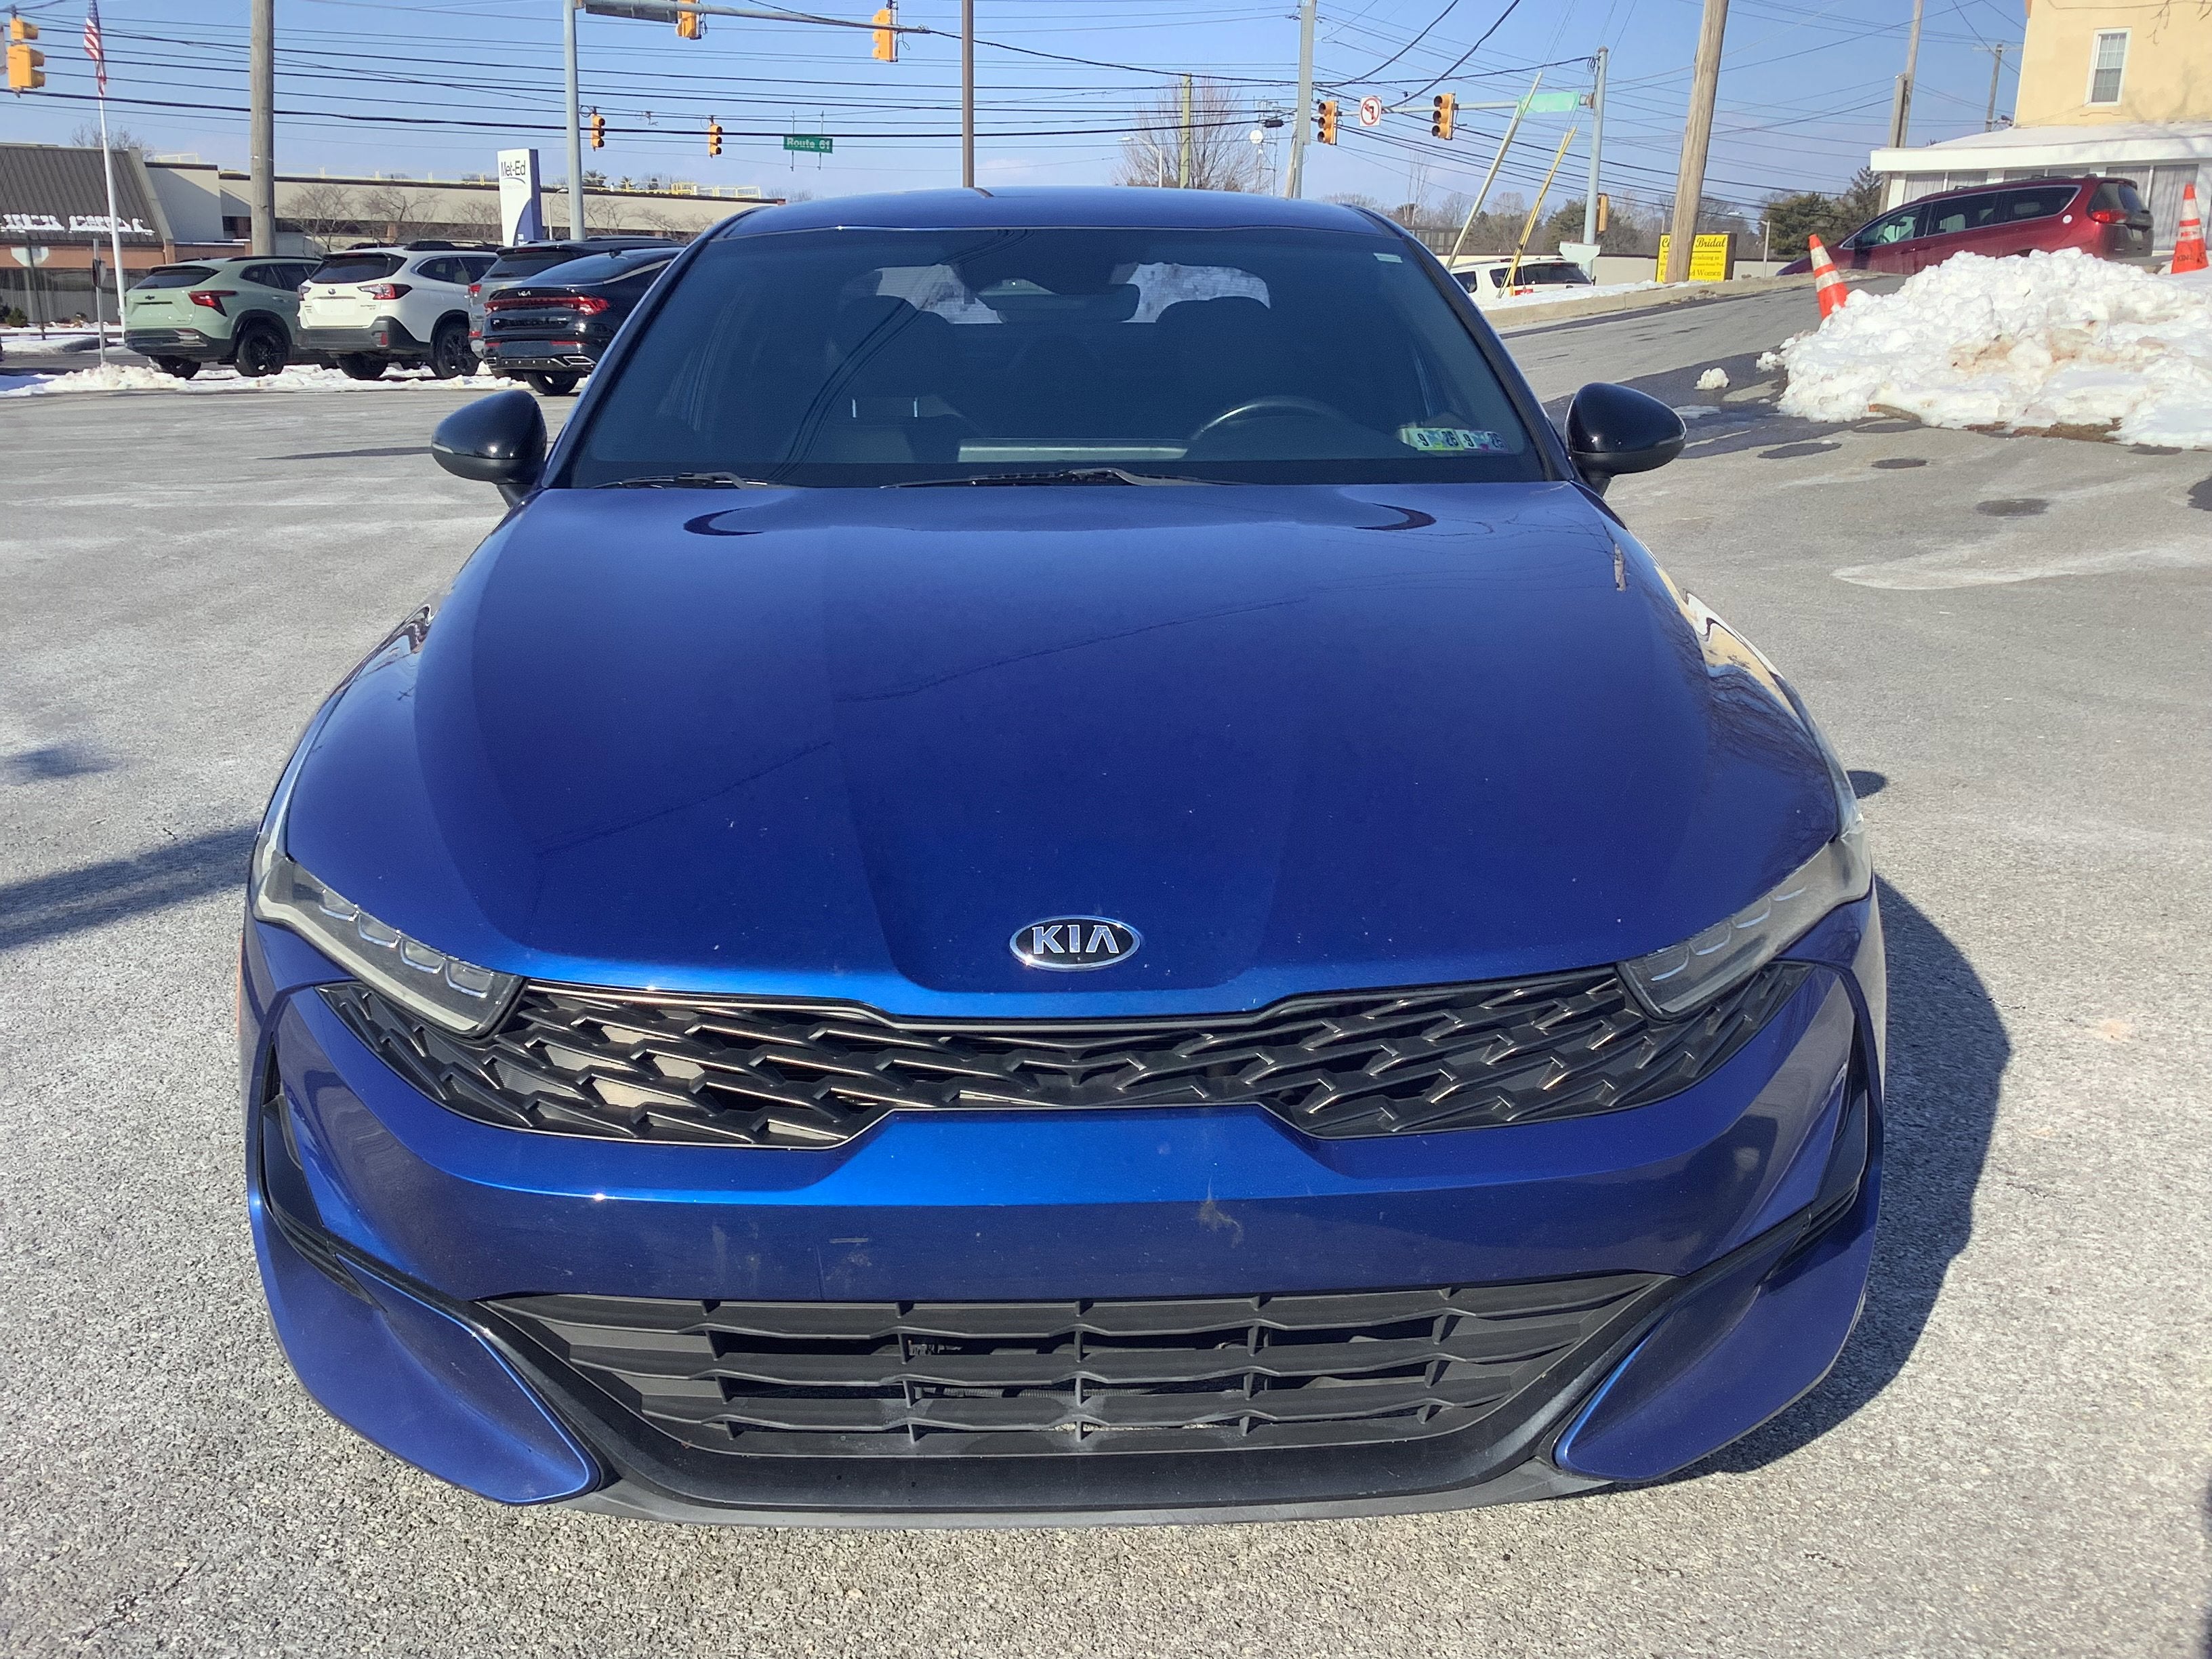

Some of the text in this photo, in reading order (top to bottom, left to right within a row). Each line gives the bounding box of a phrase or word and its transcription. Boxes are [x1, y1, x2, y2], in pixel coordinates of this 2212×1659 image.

[786, 137, 830, 150] Route 61
[501, 160, 526, 176] Met-Ed
[1695, 237, 1726, 248] Bridal
[1417, 433, 1430, 447] 9
[1031, 924, 1120, 955] KIA
